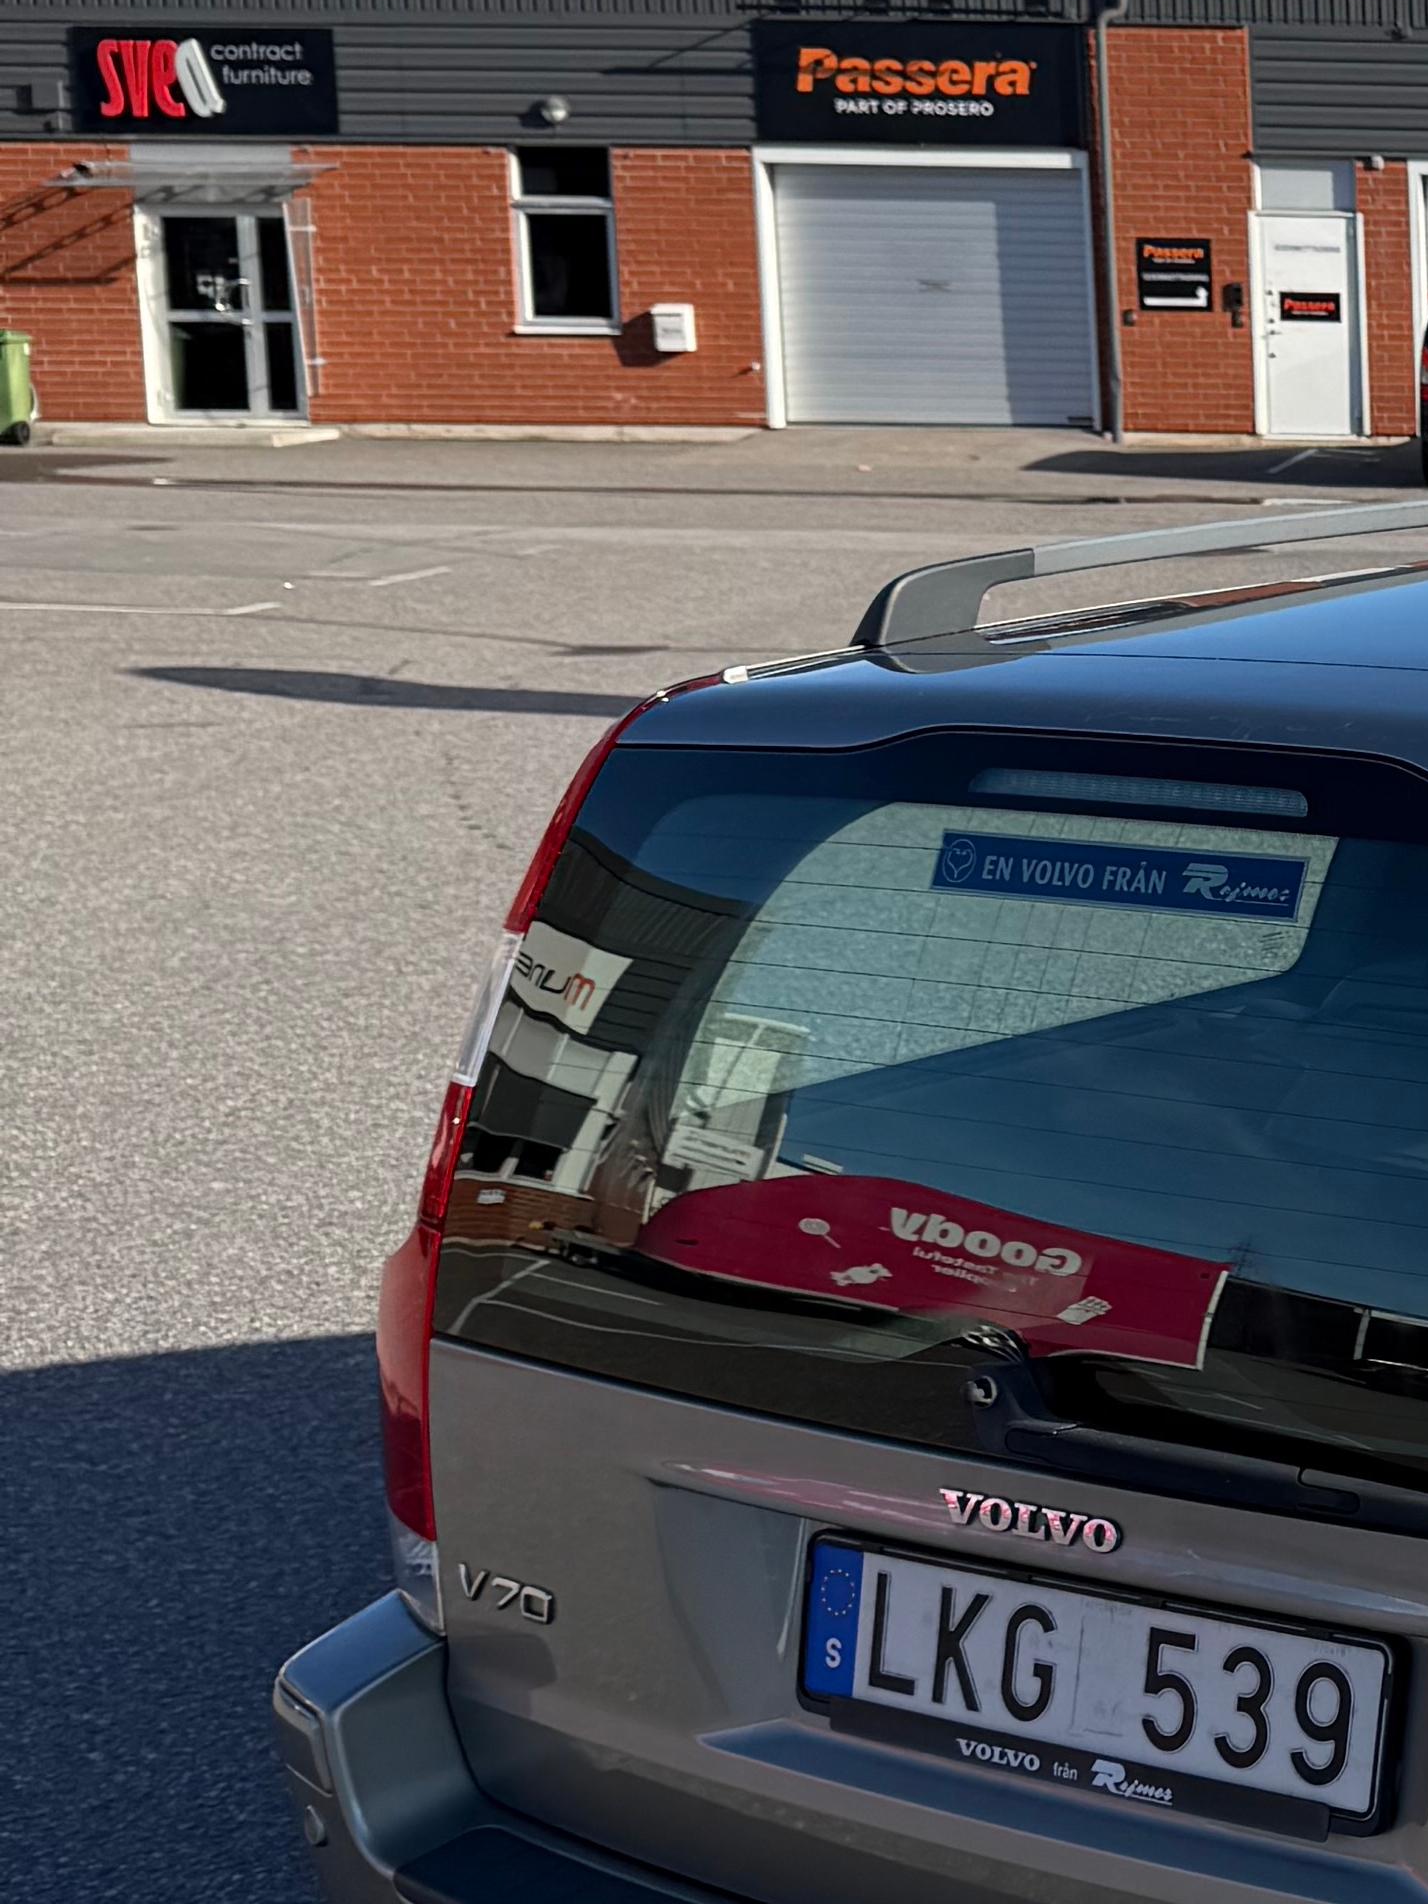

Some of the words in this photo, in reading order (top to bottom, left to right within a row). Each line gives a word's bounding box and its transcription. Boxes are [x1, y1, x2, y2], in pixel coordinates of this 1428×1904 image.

[210, 40, 302, 62] contract
[796, 47, 1033, 95] Passera
[221, 64, 313, 86] furniture
[833, 97, 880, 115] PART
[882, 99, 908, 115] OF
[911, 99, 995, 117] PROSERO
[982, 856, 1014, 882] EN
[1021, 858, 1095, 890] VOLVO
[1102, 861, 1167, 895] FRÅN
[939, 1488, 1120, 1554] VOLVO
[458, 1563, 554, 1624] V70
[825, 1637, 841, 1668] S
[867, 1571, 1058, 1722] LKG
[1141, 1626, 1354, 1787] 539
[956, 1738, 1041, 1771] VOLVO
[1053, 1761, 1078, 1781] från
